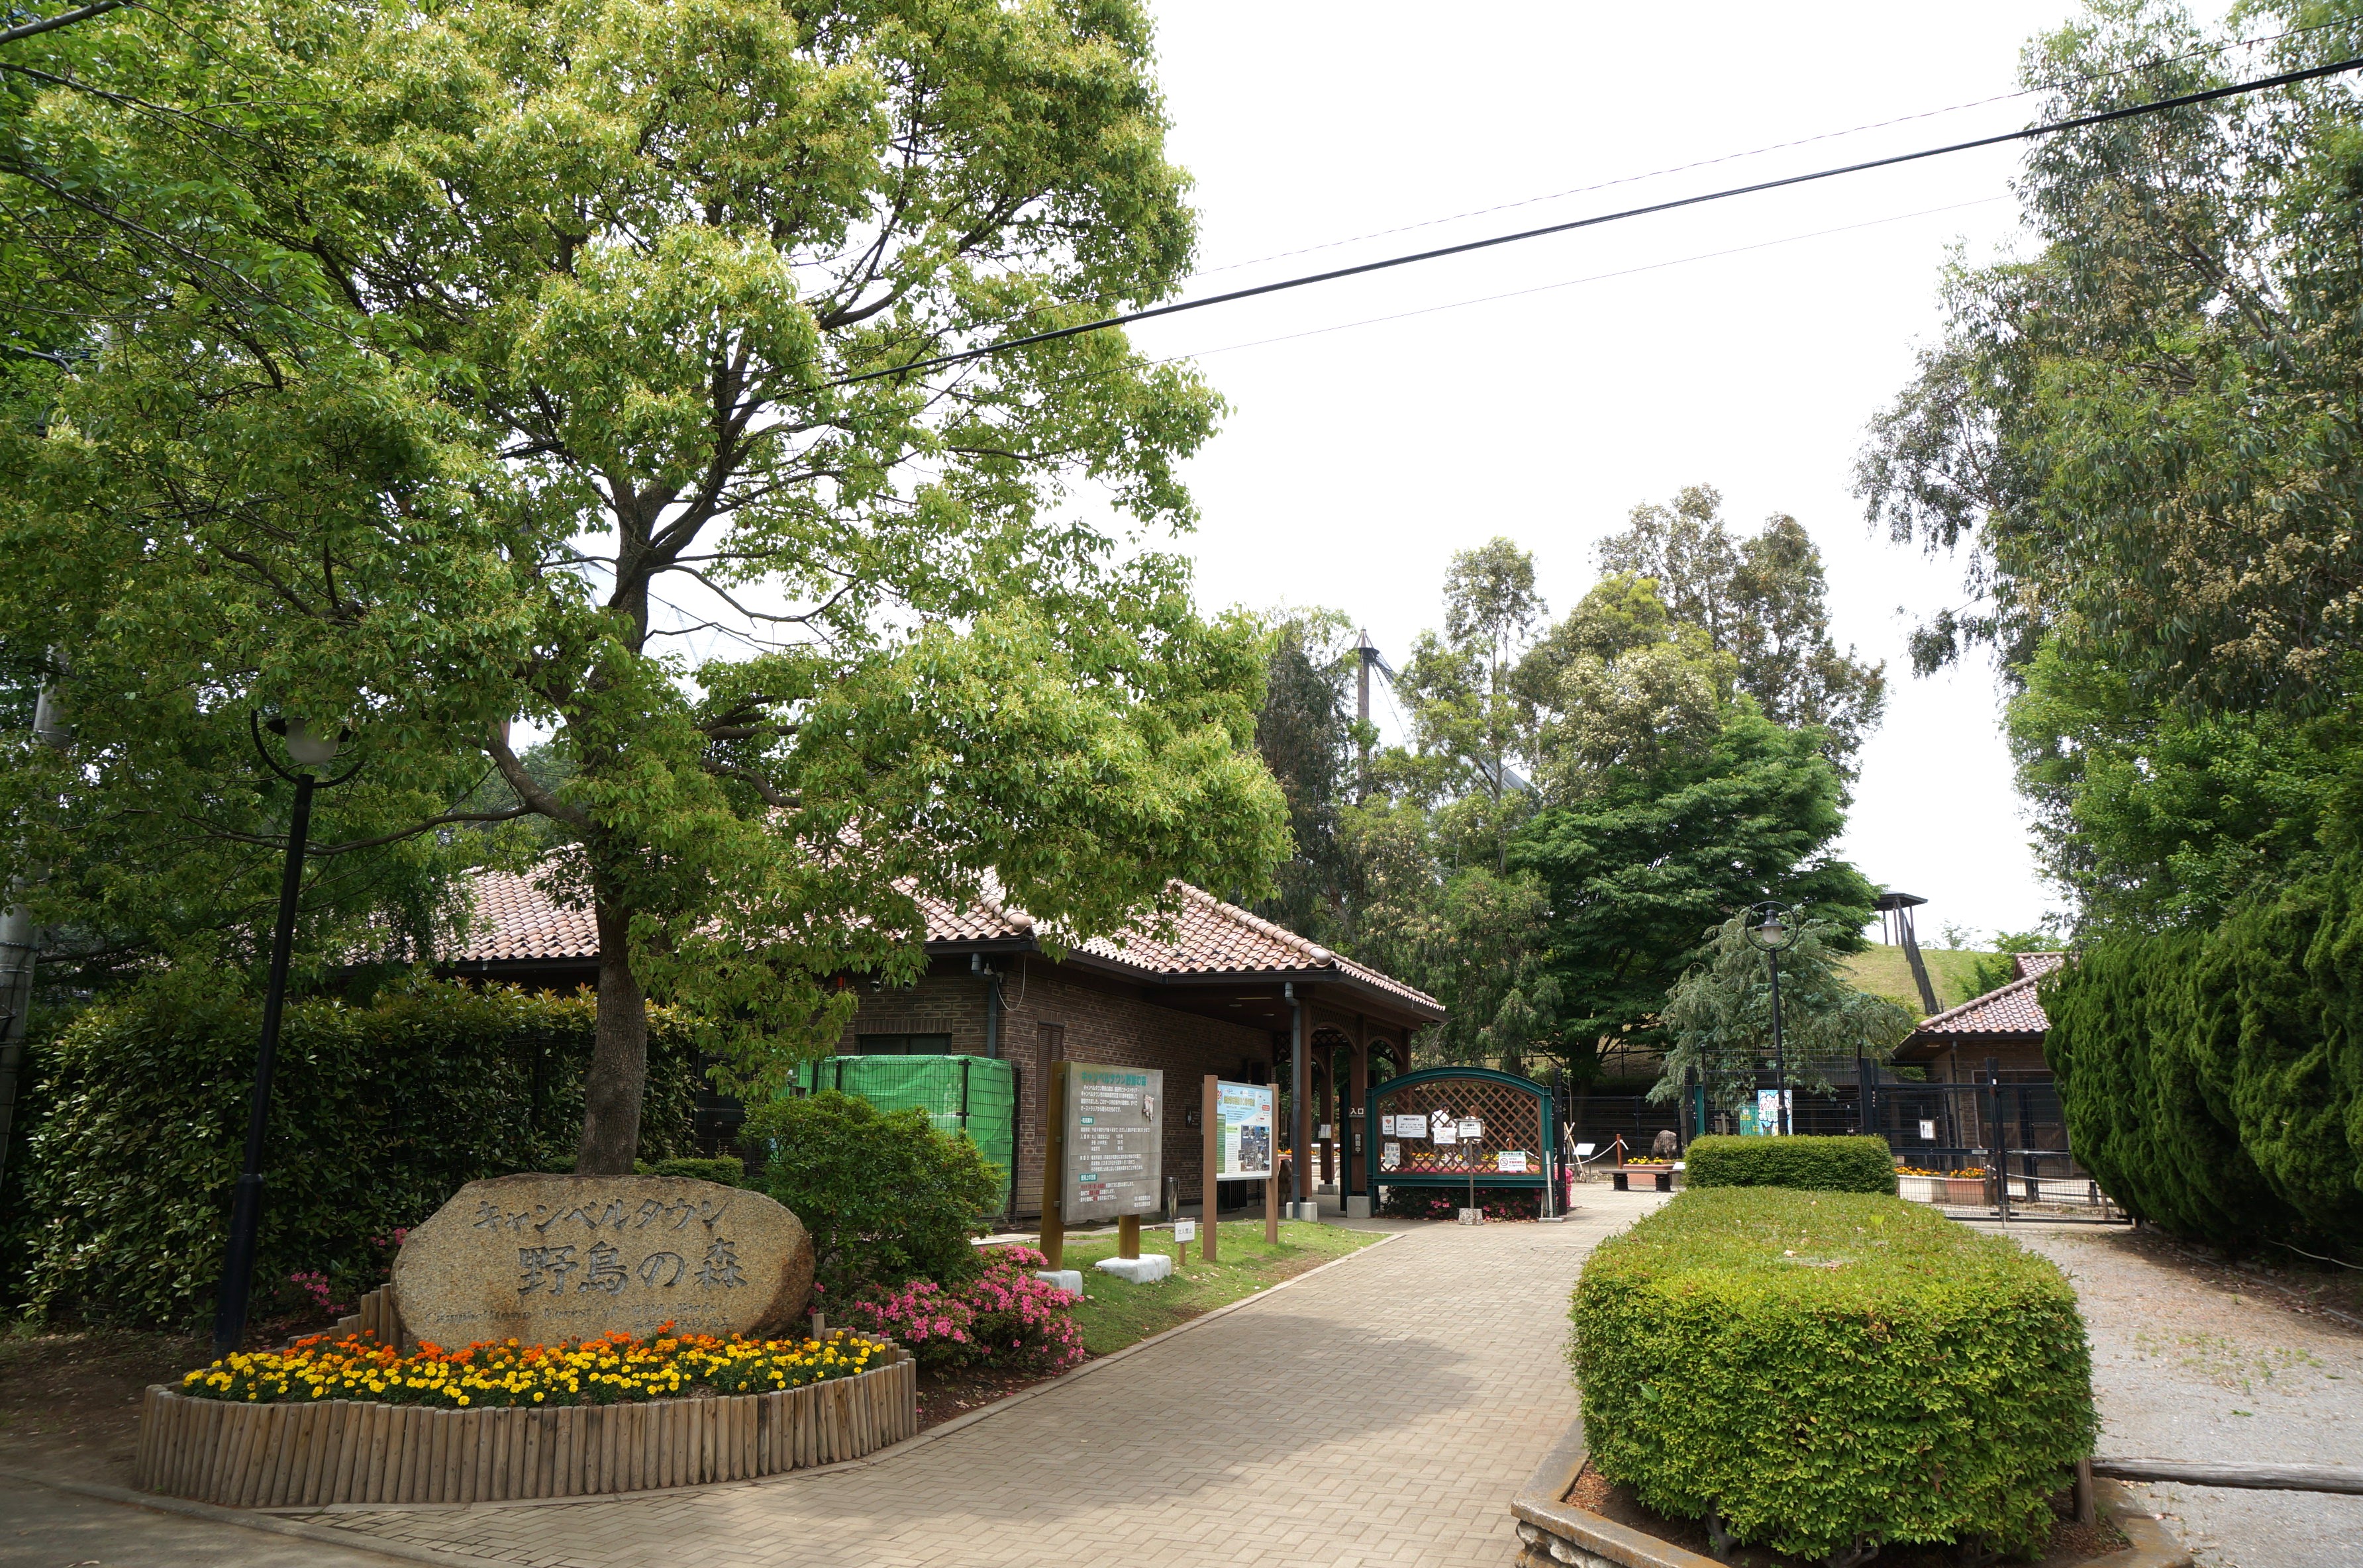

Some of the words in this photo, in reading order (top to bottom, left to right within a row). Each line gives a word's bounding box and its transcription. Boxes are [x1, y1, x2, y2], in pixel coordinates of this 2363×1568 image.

[474, 1198, 728, 1232] キャンベルタウン
[517, 1237, 747, 1296] 野鳥の森
